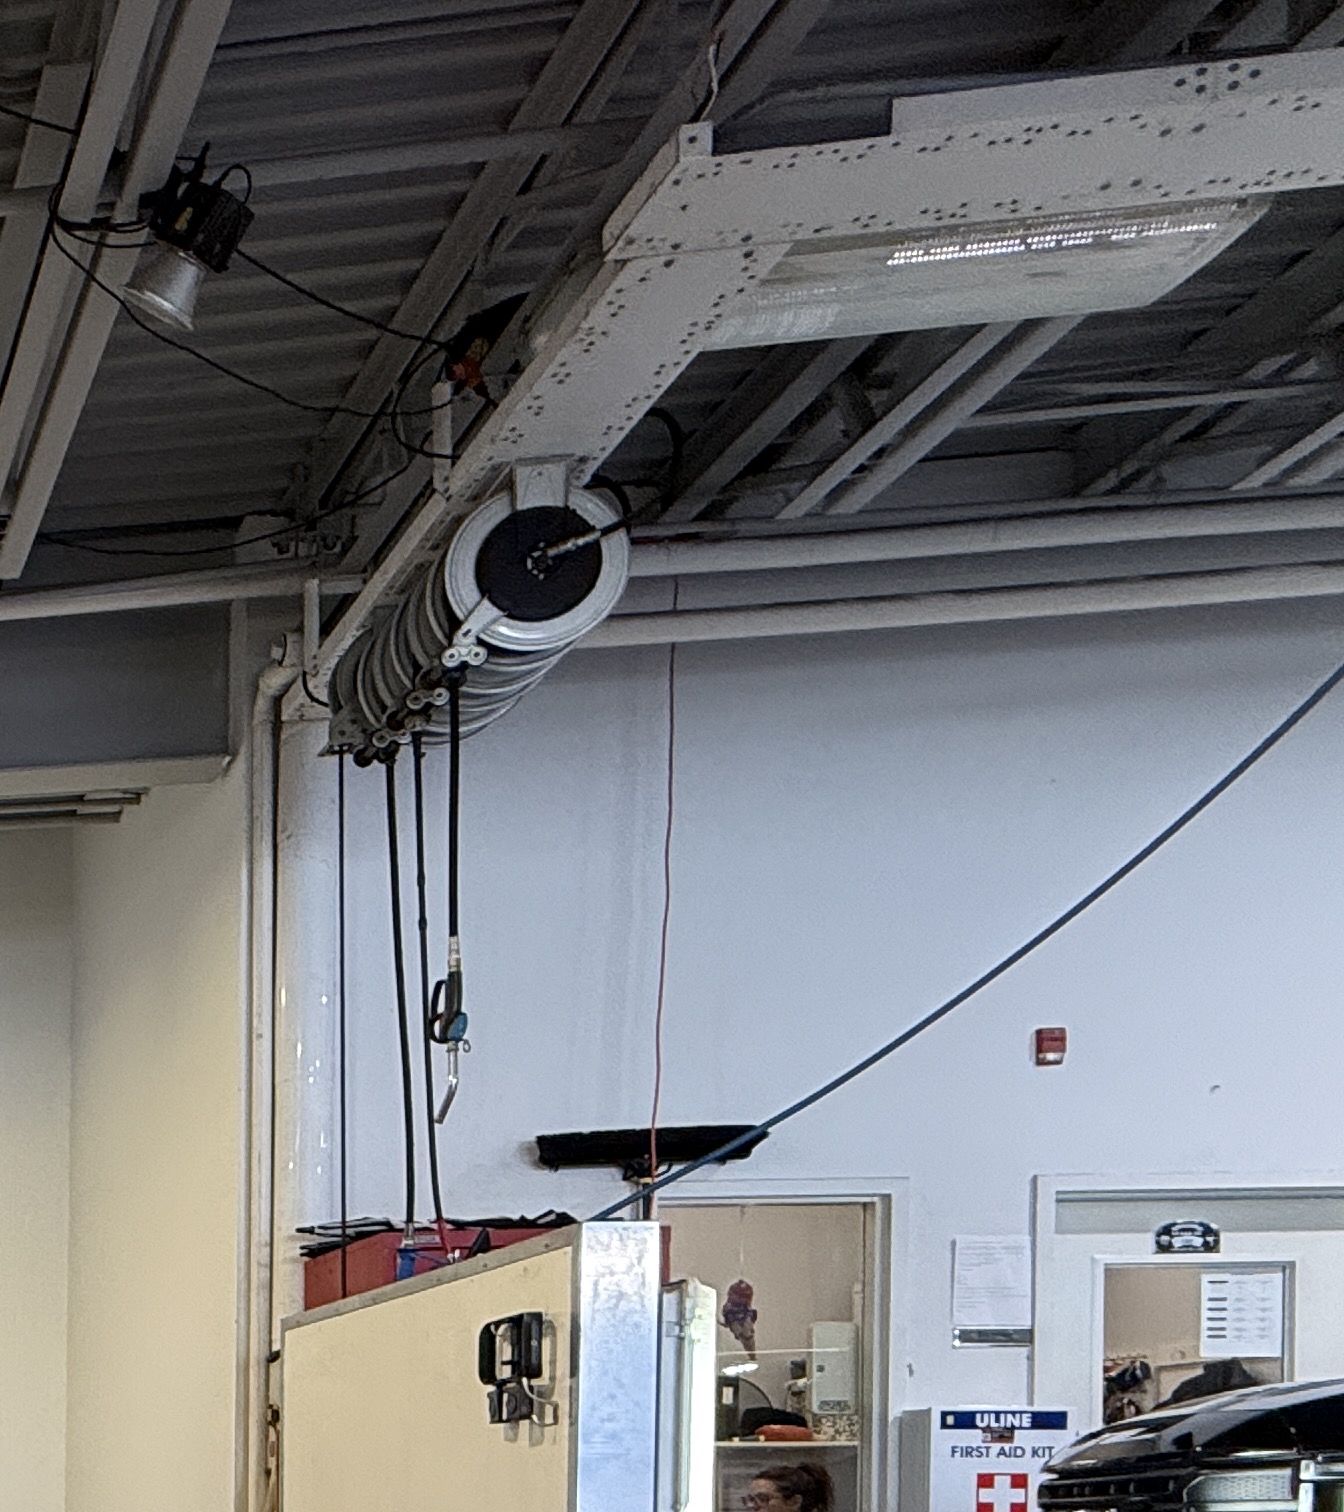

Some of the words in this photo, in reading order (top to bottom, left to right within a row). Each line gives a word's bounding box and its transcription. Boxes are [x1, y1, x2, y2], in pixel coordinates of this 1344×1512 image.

[975, 1413, 1032, 1428] ULINE
[951, 1446, 991, 1458] FIRST
[996, 1446, 1026, 1458] AID
[1031, 1446, 1055, 1459] KIT
